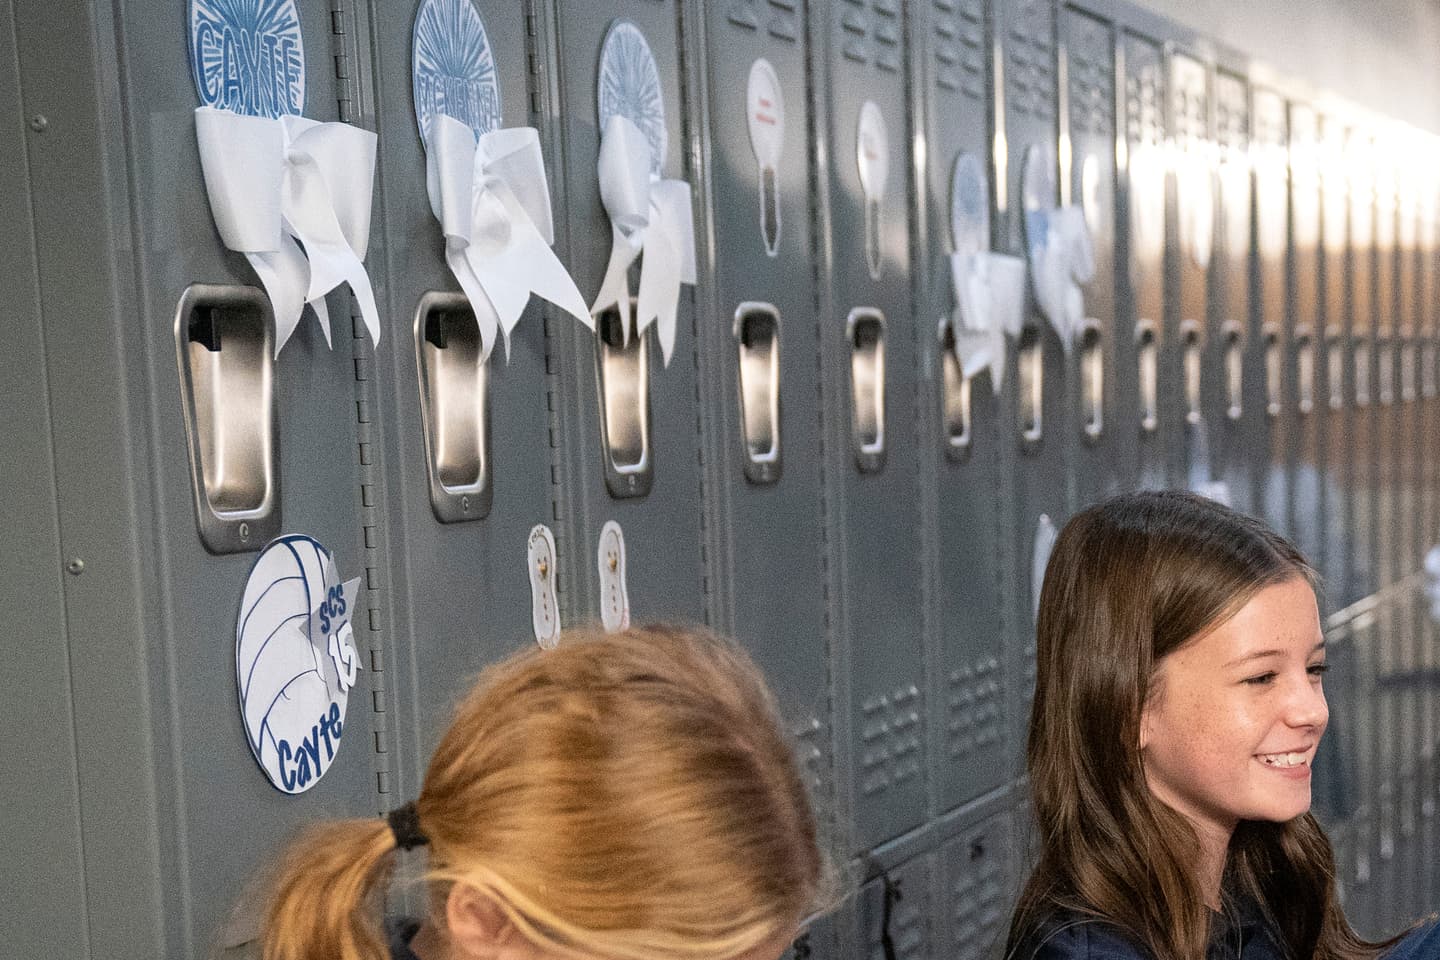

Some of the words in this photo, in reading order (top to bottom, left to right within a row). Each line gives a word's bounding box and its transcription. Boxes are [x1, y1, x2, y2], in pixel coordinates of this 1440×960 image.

[195, 20, 302, 117] CAYTE
[319, 584, 347, 635] SCS
[278, 701, 343, 792] Cayte
